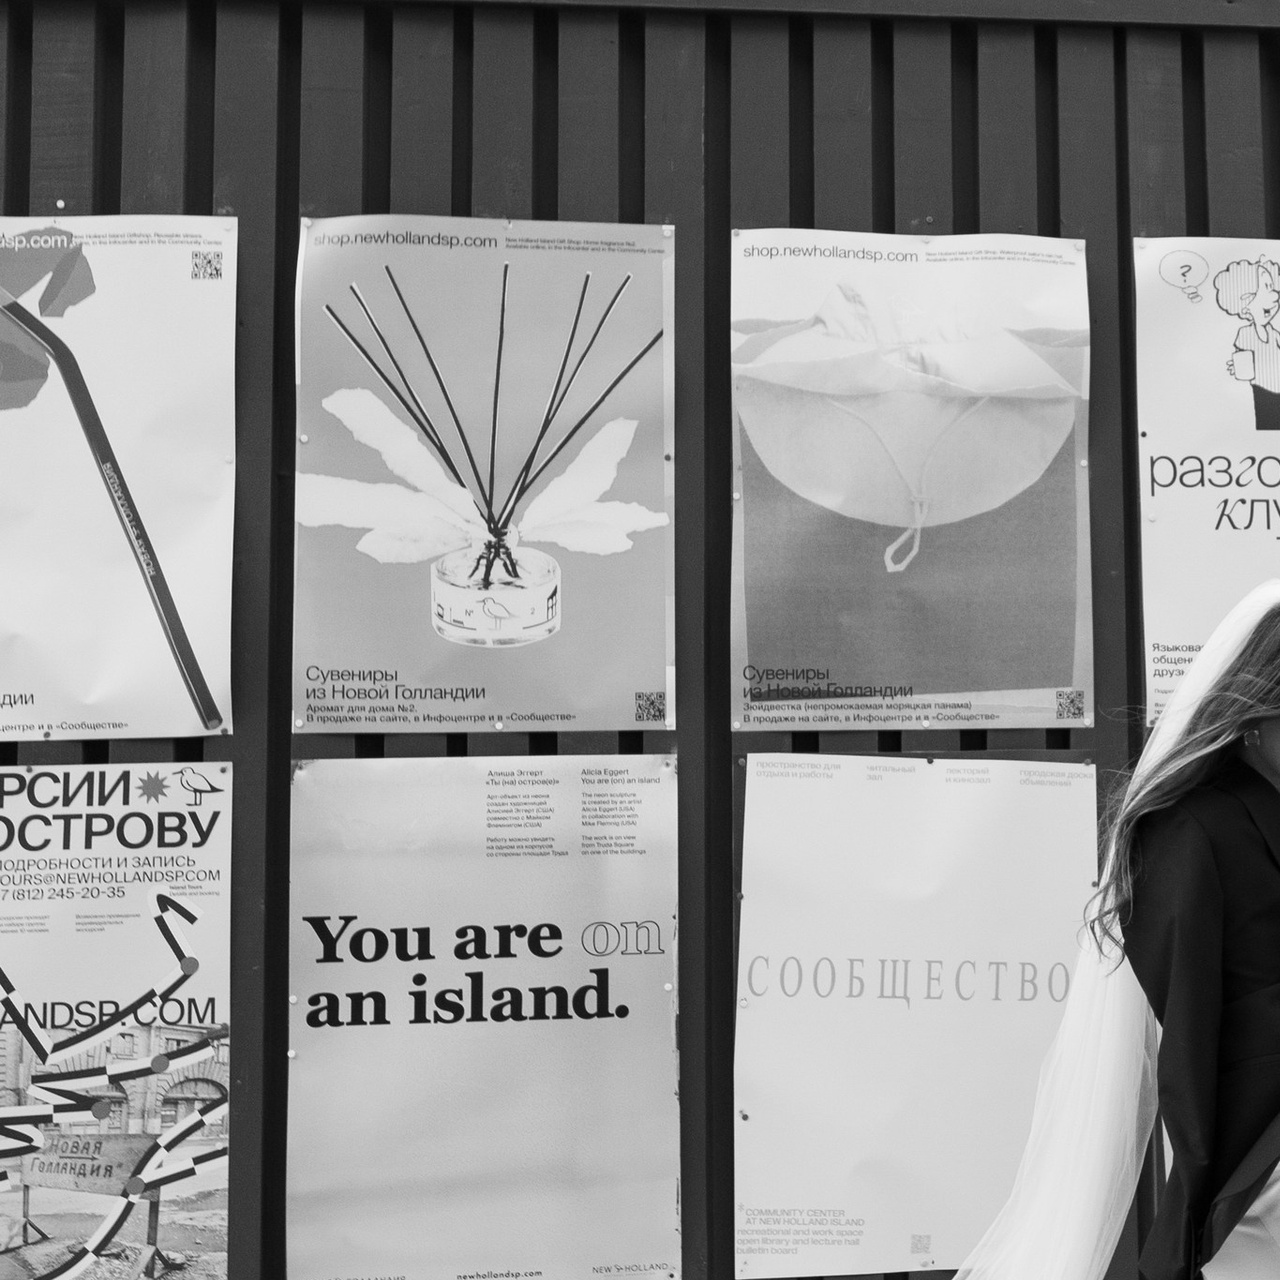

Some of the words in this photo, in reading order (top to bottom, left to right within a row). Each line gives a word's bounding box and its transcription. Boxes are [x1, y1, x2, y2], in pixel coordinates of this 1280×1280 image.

[314, 230, 498, 249] shop.newhollandsp.com
[743, 245, 919, 262] shop.newhollandsp.com
[1152, 642, 1204, 653] Языкова
[306, 665, 398, 684] Сувениры
[742, 665, 830, 683] Сувениры
[306, 688, 326, 699] из
[331, 684, 389, 700] Новой
[394, 685, 486, 702] Голландии
[743, 686, 763, 699] из
[768, 683, 823, 699] Новой
[826, 682, 914, 700] Голландии
[306, 704, 344, 714] Аромат
[346, 705, 366, 715] для
[368, 705, 395, 714] дома
[886, 701, 931, 712] моряцкая
[306, 714, 314, 722] В
[316, 715, 362, 724] продаже
[379, 713, 411, 723] сайте,
[422, 713, 486, 723] Инфоцентре
[505, 712, 577, 722] «Сообществе»
[743, 714, 751, 723] В
[753, 715, 796, 725] продаже
[798, 715, 812, 723] на
[813, 713, 843, 724] сайте,
[853, 713, 913, 724] Инфоцентре
[915, 714, 922, 722] и
[581, 768, 602, 776] Alicia
[603, 768, 629, 777] Eggert
[581, 777, 595, 785] You
[638, 776, 661, 784] island
[117, 856, 128, 868] И
[131, 855, 196, 869] ЗАПИСЬ
[1, 889, 9, 902] 7
[12, 887, 44, 902] (812)
[47, 885, 126, 900] 245-20-35
[302, 915, 436, 964] You
[453, 922, 564, 961] are
[581, 920, 665, 957] on
[746, 955, 1071, 1009] СООБЩЕСТВО
[305, 990, 391, 1028] an
[408, 967, 630, 1025] island.
[745, 1208, 805, 1217] COMMUNITY
[806, 1209, 846, 1217] CENTER
[759, 1217, 781, 1225] NEW
[782, 1218, 829, 1226] HOLLAND
[592, 1266, 612, 1274] NEW
[624, 1262, 669, 1272] HOLLAND
